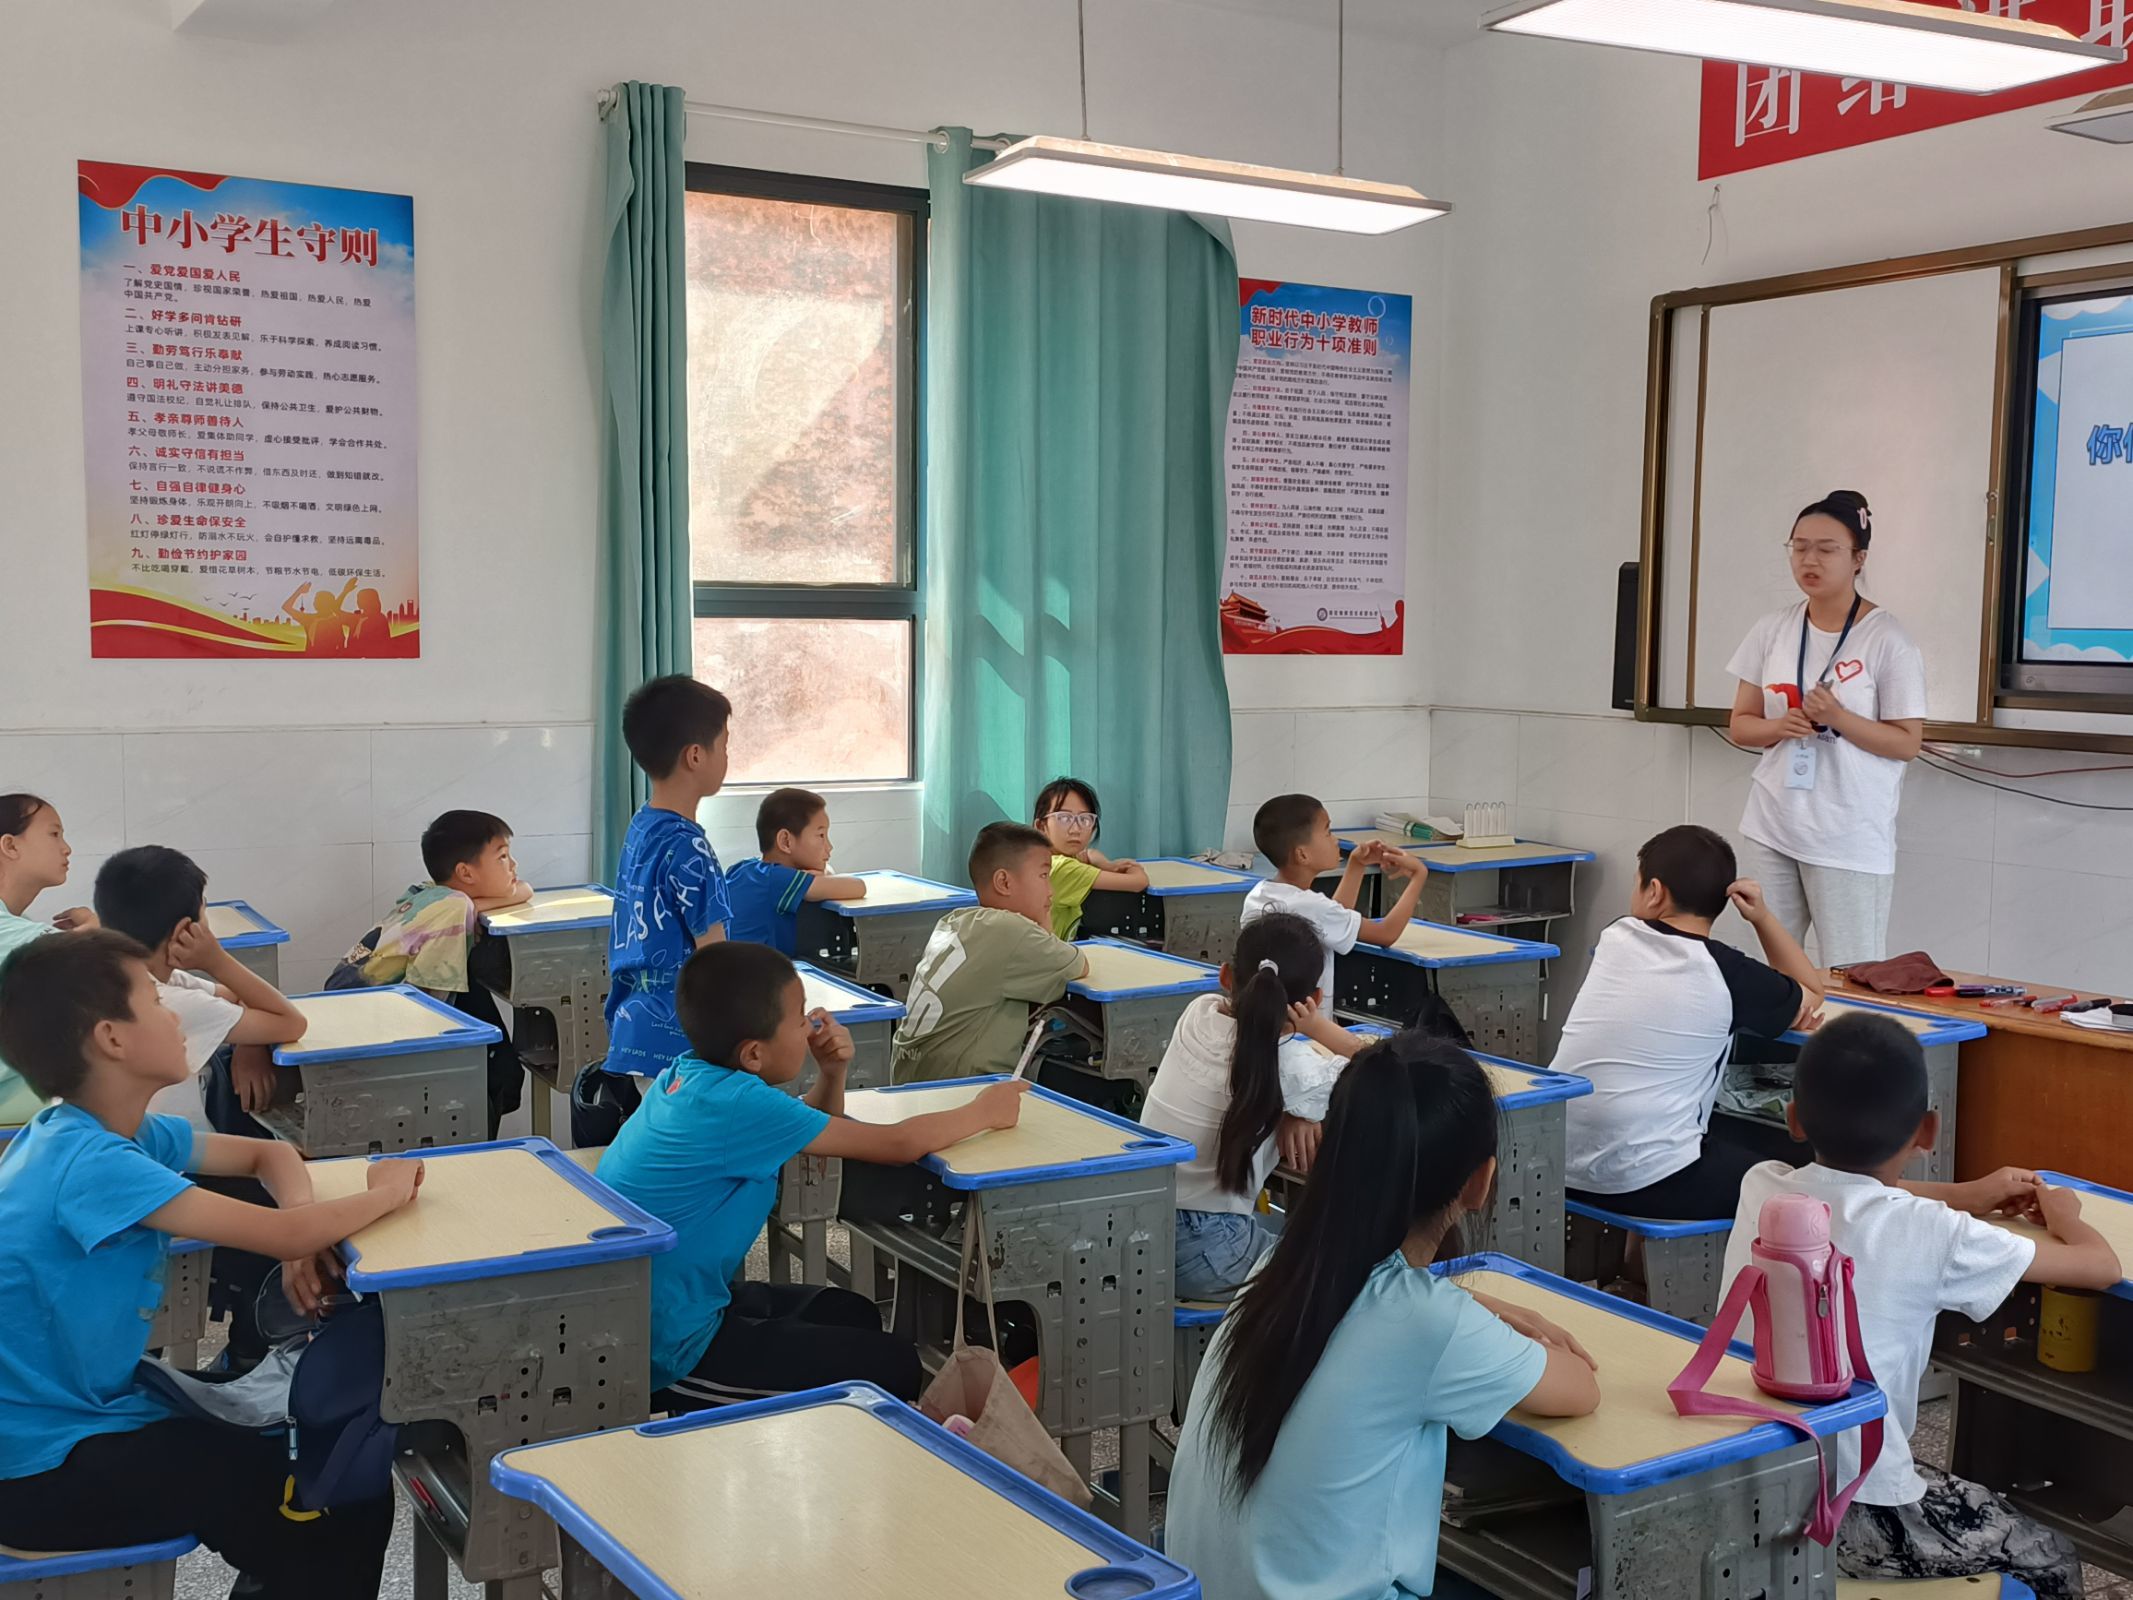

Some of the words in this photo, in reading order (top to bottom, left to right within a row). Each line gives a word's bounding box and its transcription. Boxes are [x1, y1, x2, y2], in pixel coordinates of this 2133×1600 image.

[120, 204, 380, 267] 中小学生守则
[123, 263, 241, 283] 一、爱党爱国爱人民
[125, 308, 242, 327] 二、好学多问肯钻研
[1251, 305, 1379, 336] 新时代中小学教师
[1250, 328, 1378, 357] 职业行为十项准则
[127, 376, 244, 395] 四、明礼守法讲美德
[127, 410, 244, 428] 五、孝亲尊师善待人
[128, 445, 245, 462] 六、诚实守信有担当
[129, 479, 246, 495] 七、自强自律健身心
[130, 513, 247, 528] 八、珍爱生命保安全
[131, 547, 247, 562] 九、勤俭节约护家园
